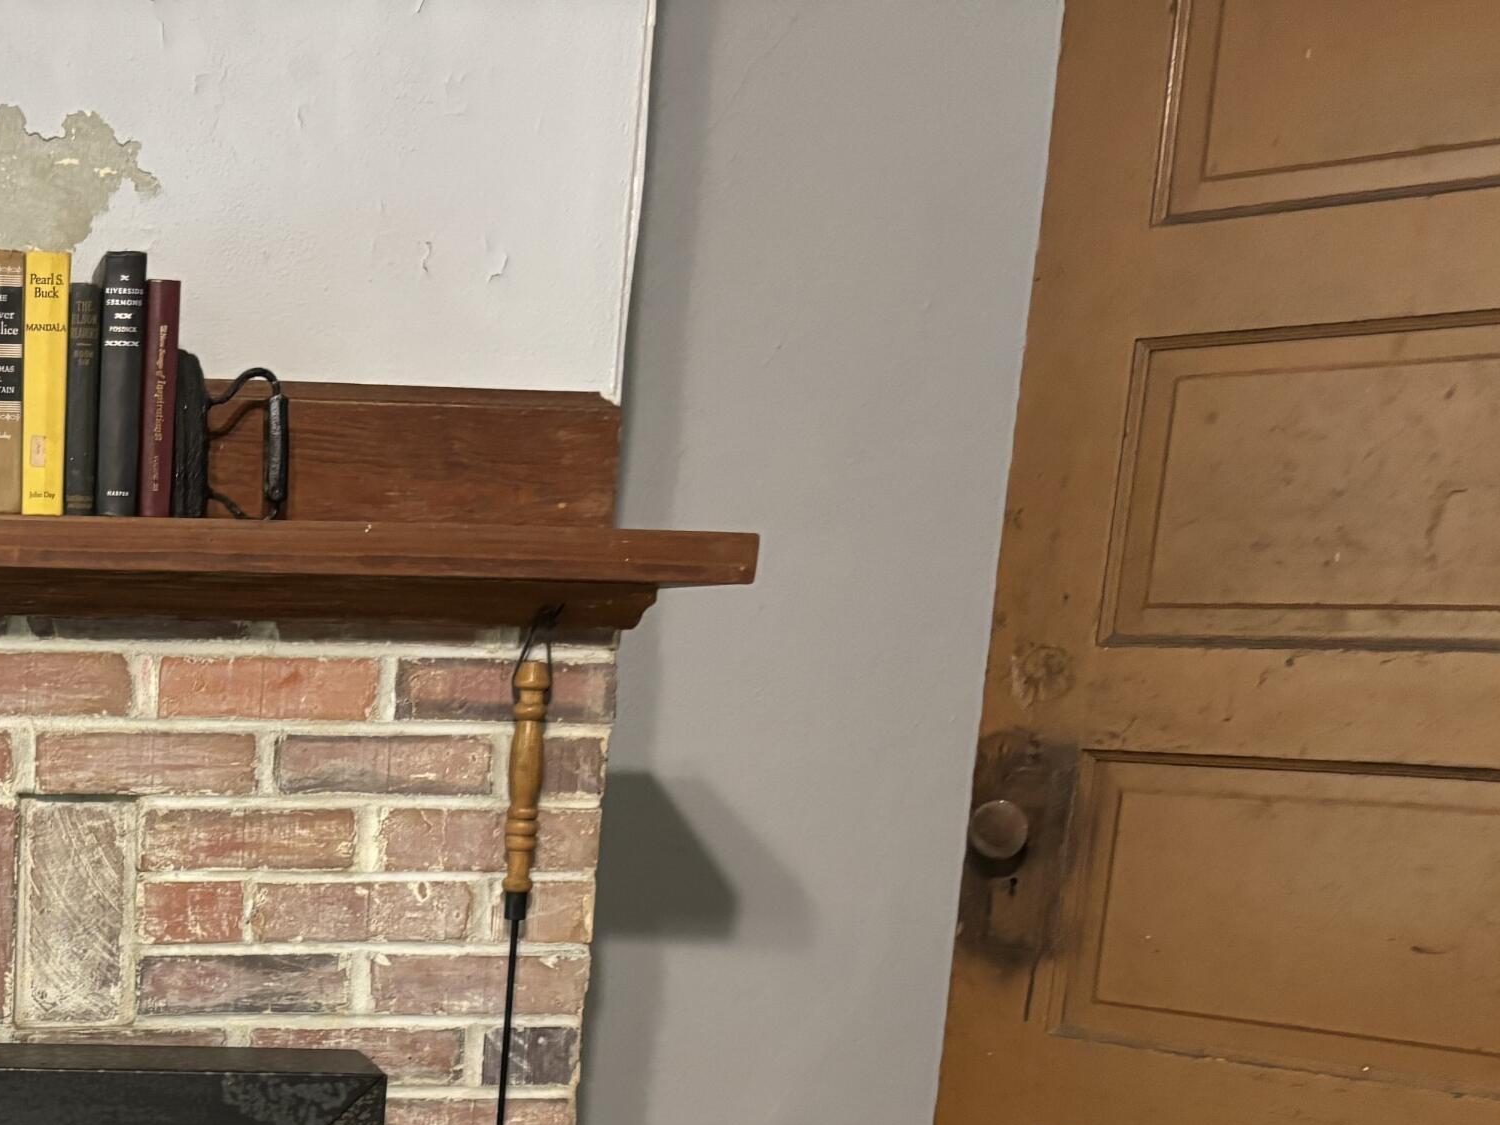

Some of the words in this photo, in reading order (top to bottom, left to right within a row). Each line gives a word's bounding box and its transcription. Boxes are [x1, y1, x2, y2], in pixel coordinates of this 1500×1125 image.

[29, 273, 53, 285] Pearl
[55, 274, 64, 285] S.
[33, 286, 60, 299] Buck
[25, 323, 67, 332] MANDALA
[29, 491, 43, 499] John
[43, 491, 56, 500] Day
